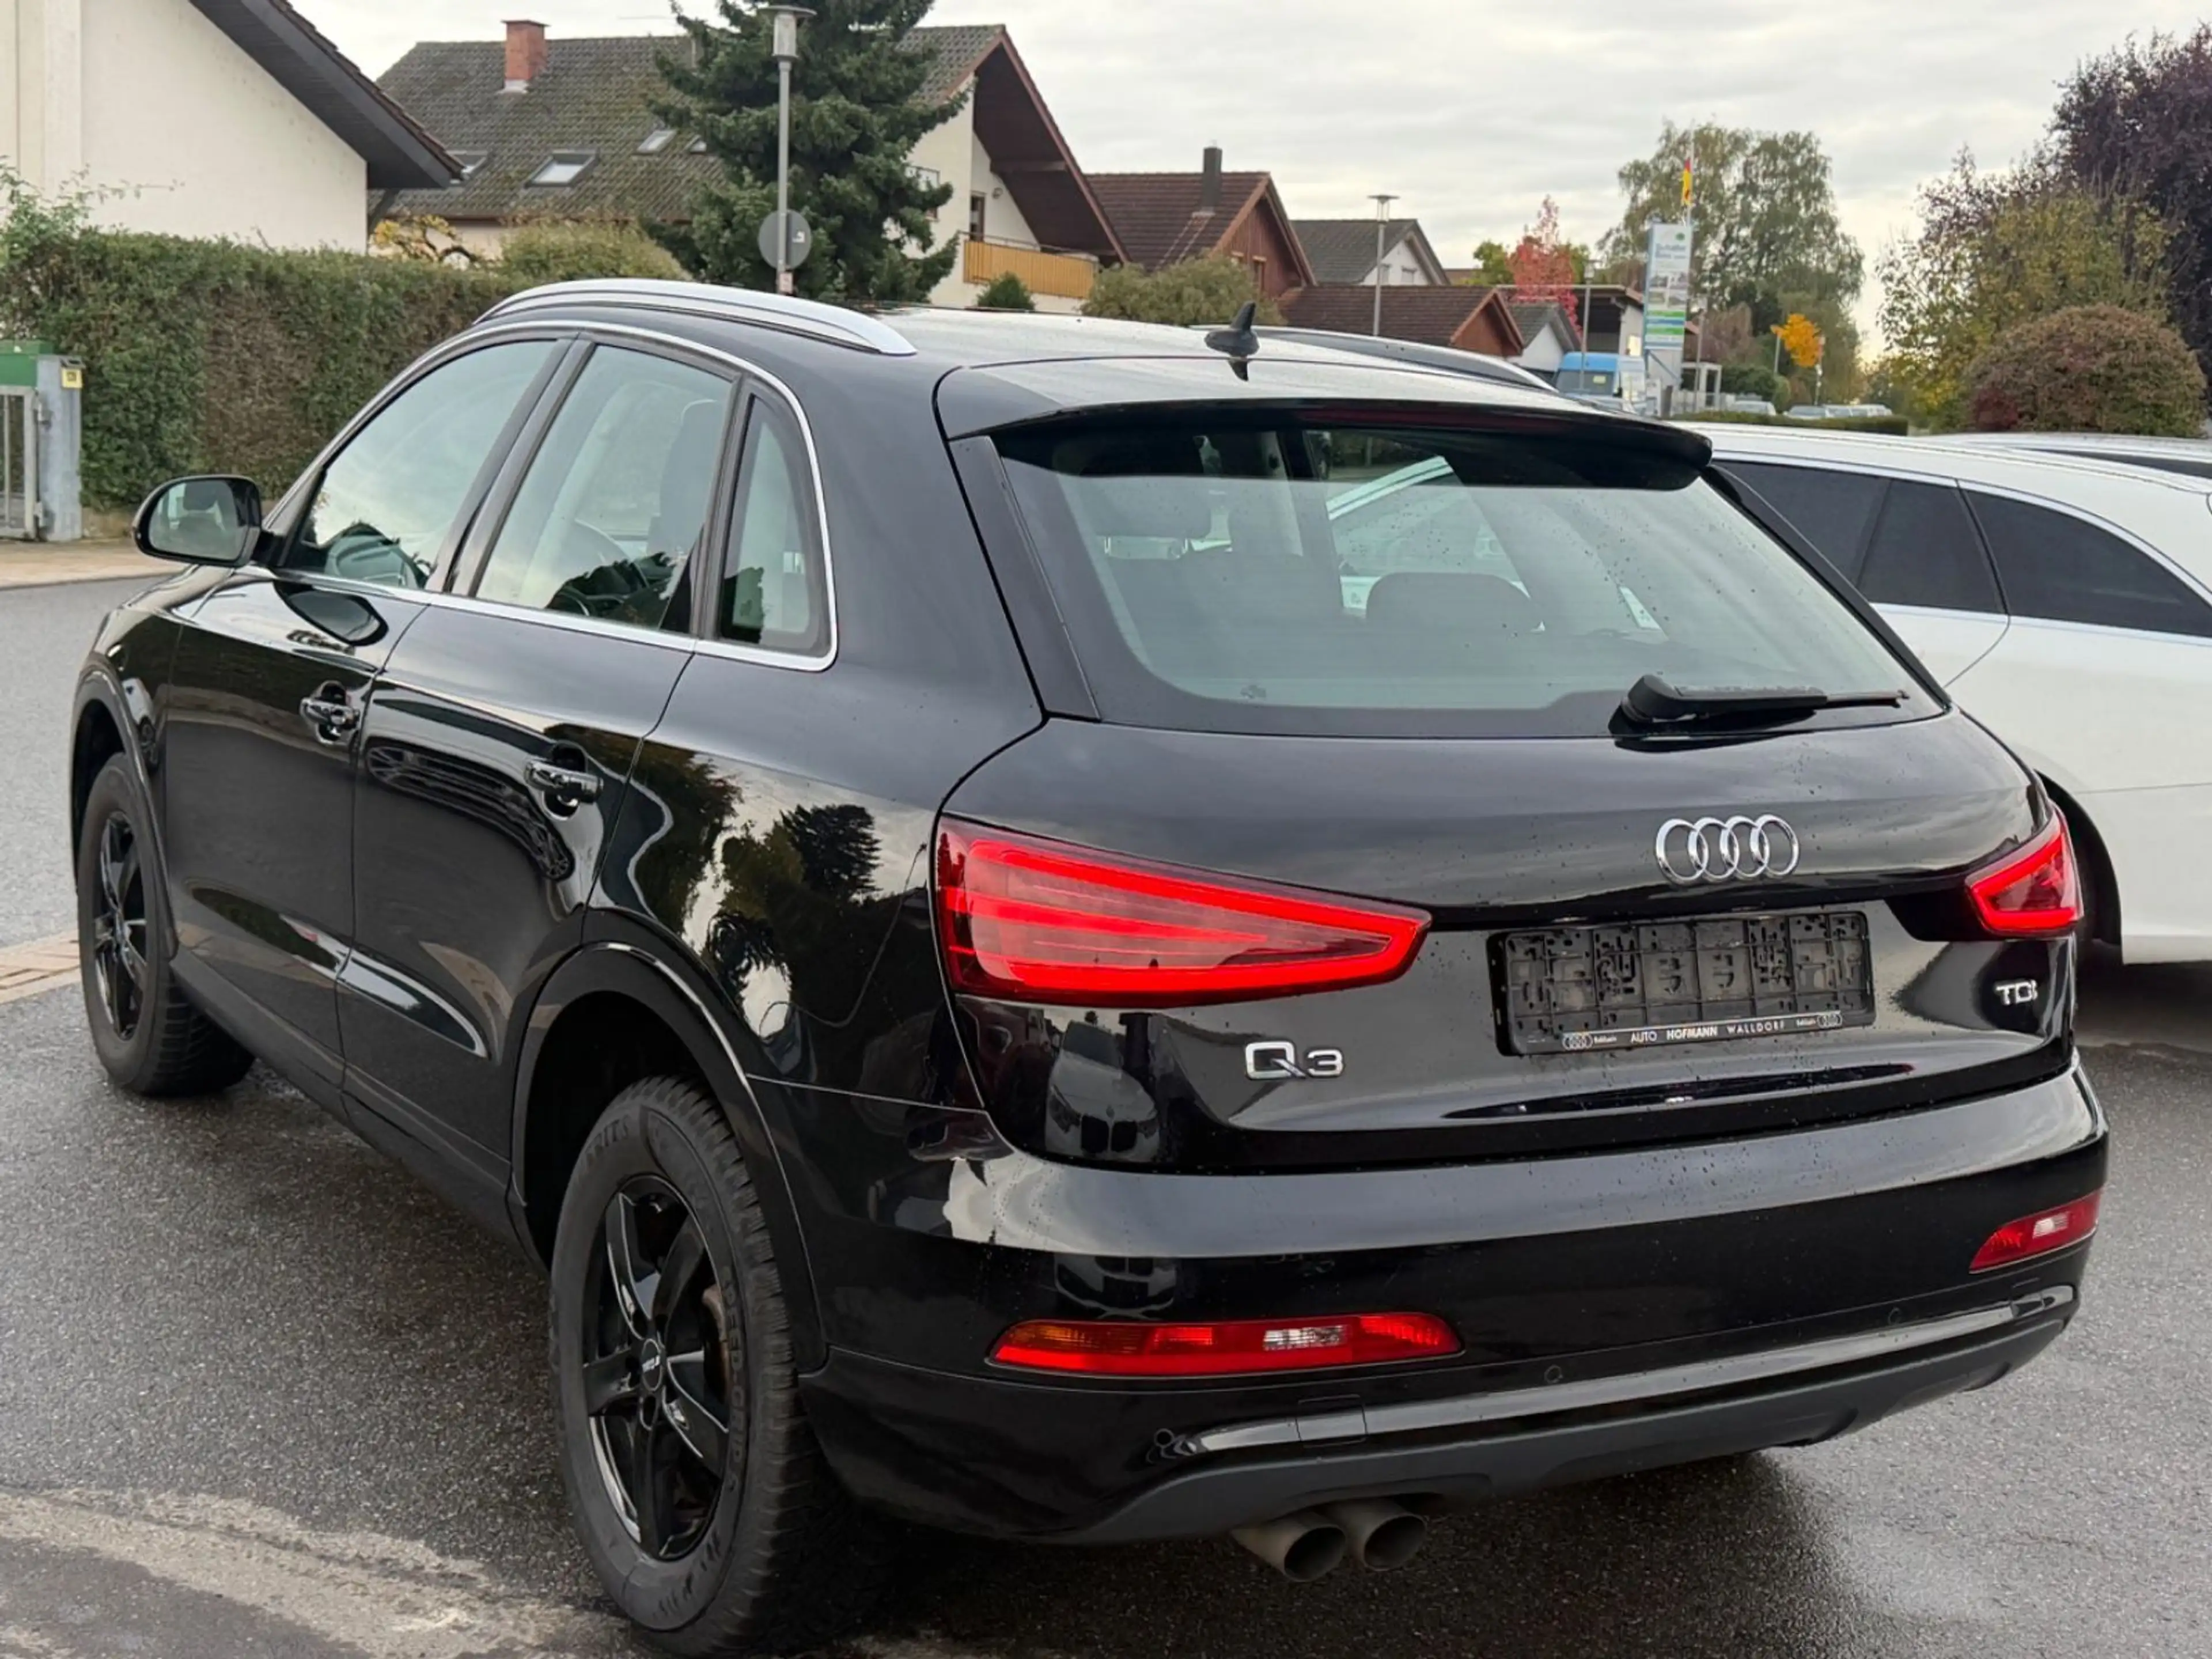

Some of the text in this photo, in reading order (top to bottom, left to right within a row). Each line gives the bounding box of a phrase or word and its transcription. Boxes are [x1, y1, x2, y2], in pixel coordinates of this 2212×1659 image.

[1995, 979, 2038, 1005] TDI
[1631, 1031, 1657, 1044] AUTO
[1666, 1026, 1718, 1040] HOFMANN
[1245, 1040, 1344, 1080] Q3
